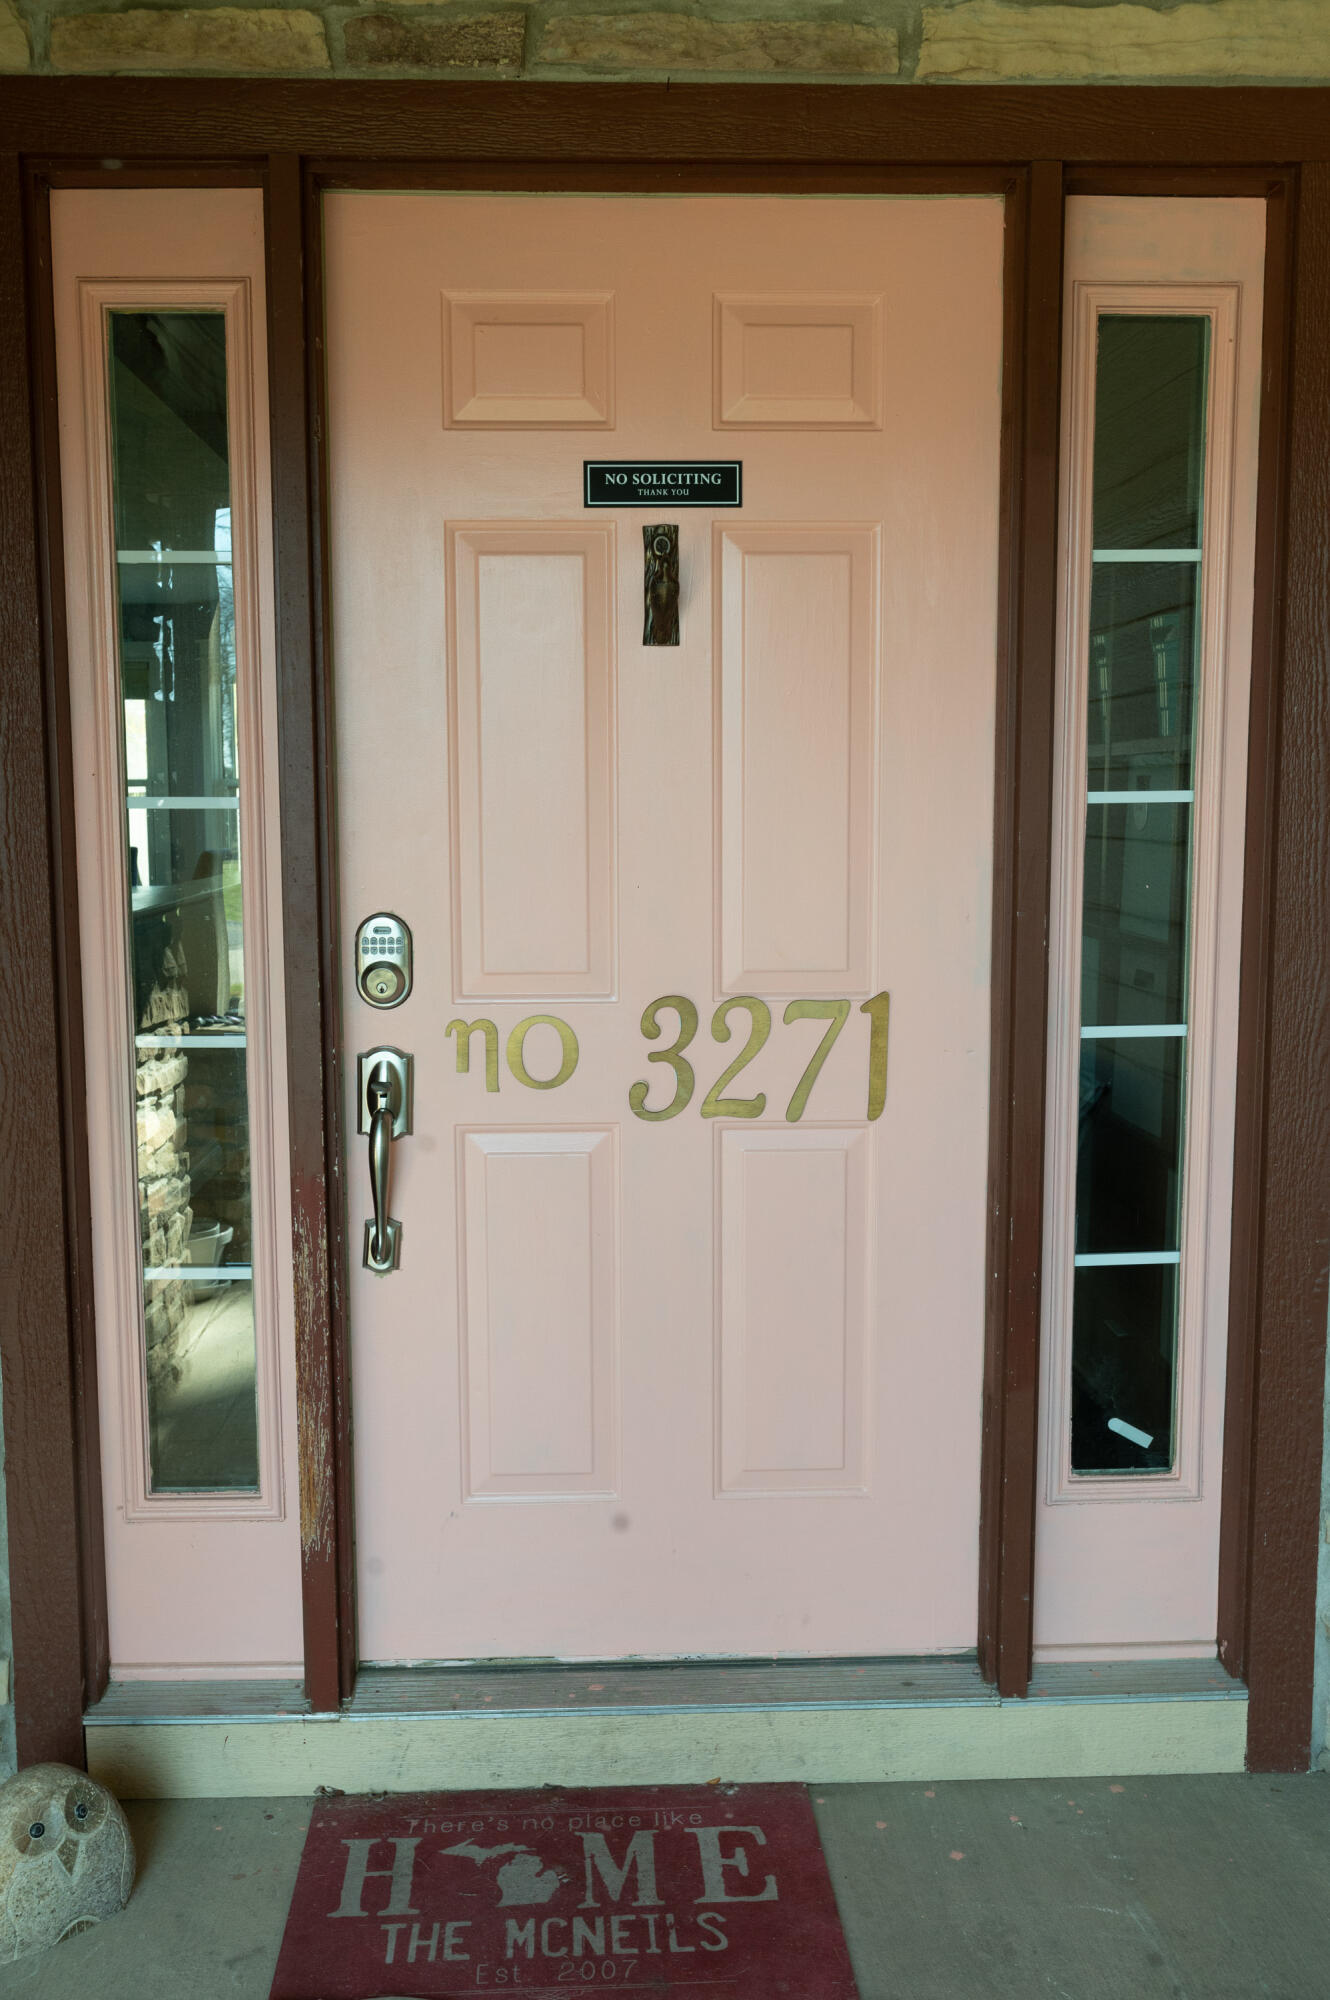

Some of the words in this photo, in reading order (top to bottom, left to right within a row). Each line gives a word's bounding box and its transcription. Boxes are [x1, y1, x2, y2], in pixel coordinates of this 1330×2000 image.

[605, 473, 628, 485] NO
[632, 473, 722, 485] SOLICITING
[638, 488, 669, 496] THANK
[671, 488, 689, 496] YOU
[628, 991, 891, 1122] 3271
[406, 1816, 509, 1834] There's
[521, 1815, 555, 1831] no
[568, 1814, 641, 1833] place
[654, 1811, 703, 1827] like
[380, 1920, 472, 1964] THE
[504, 1911, 729, 1960] MCNEILS
[557, 1959, 639, 1982] 2007
